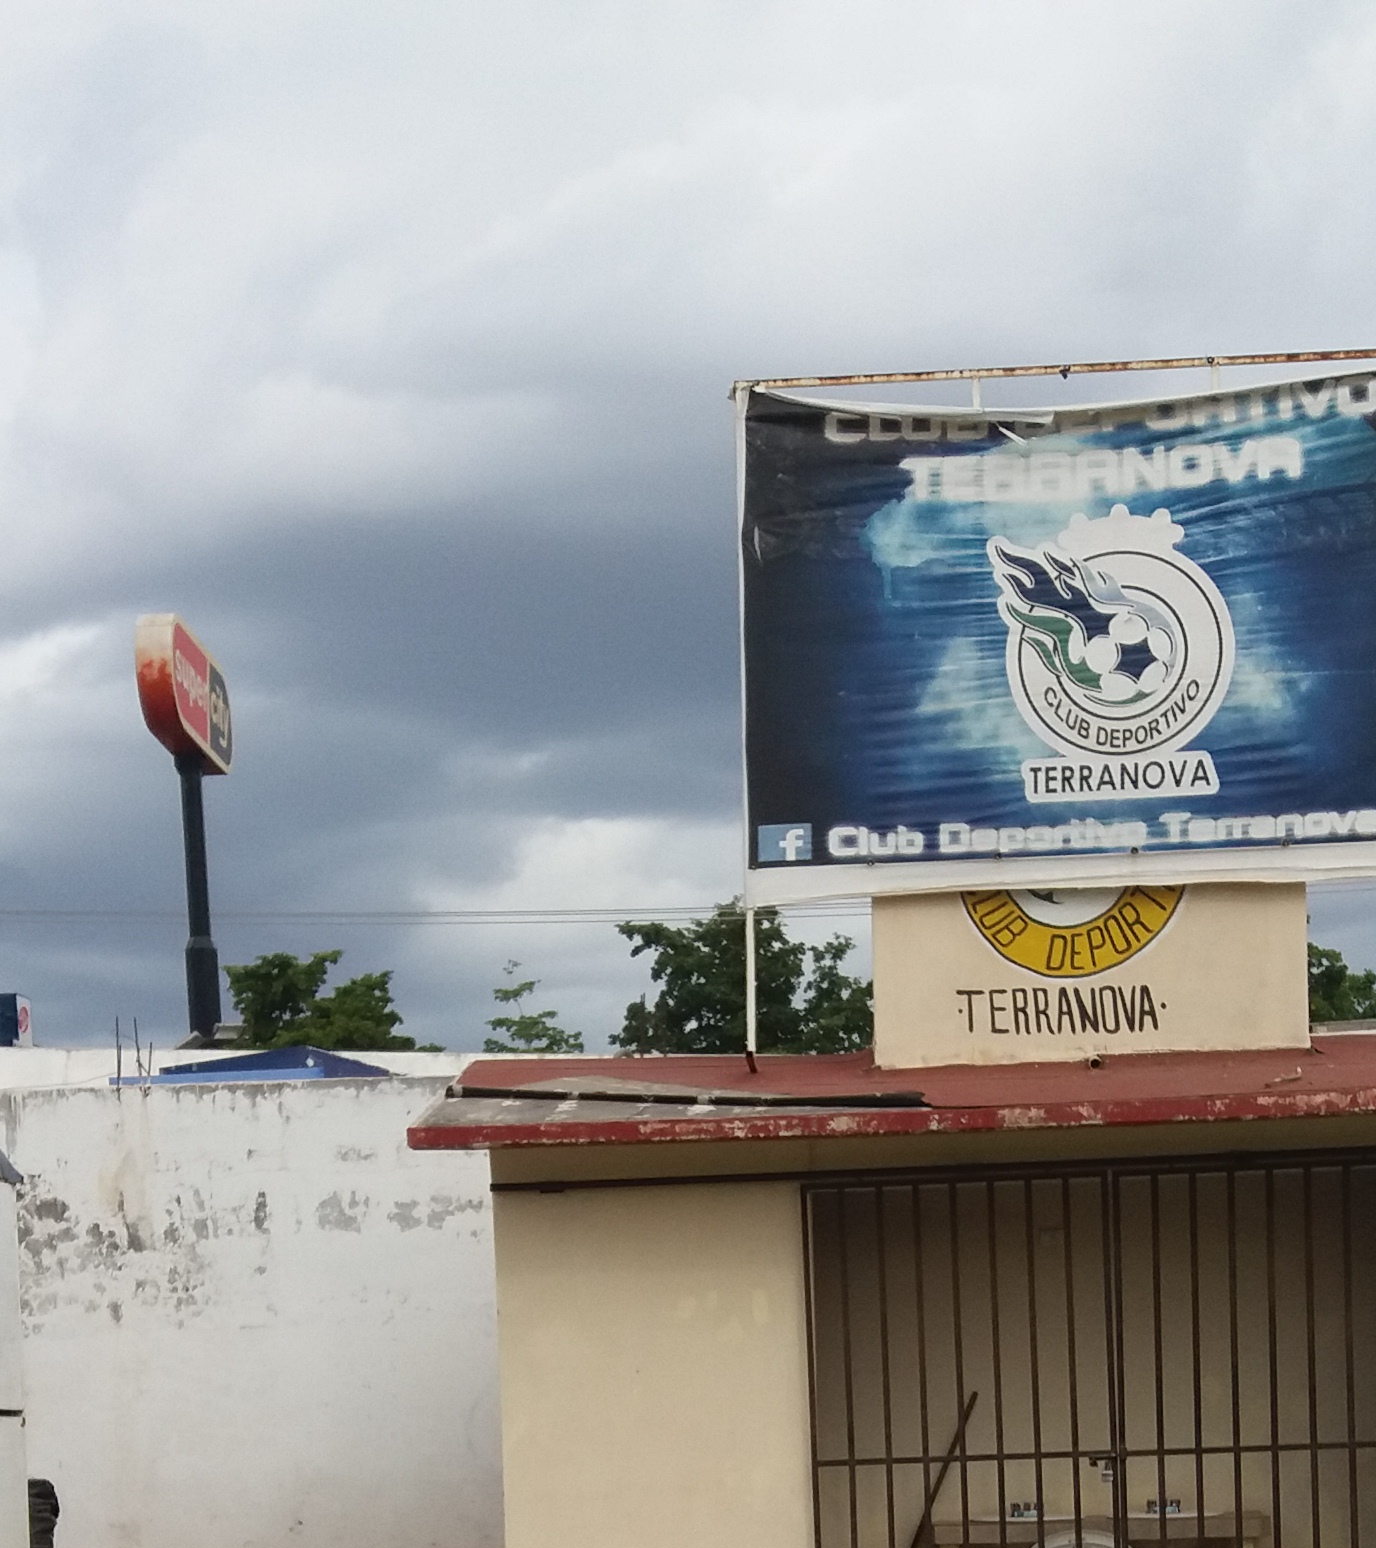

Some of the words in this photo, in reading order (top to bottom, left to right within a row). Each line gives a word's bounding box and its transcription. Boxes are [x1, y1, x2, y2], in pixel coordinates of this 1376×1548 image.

[899, 436, 1302, 502] TERRANOVA
[1044, 686, 1091, 740] CLUB
[1096, 679, 1200, 748] DEPORTIVO
[1029, 758, 1211, 795] TERRANOVA
[827, 821, 925, 857] Club
[966, 890, 1029, 948] LUB
